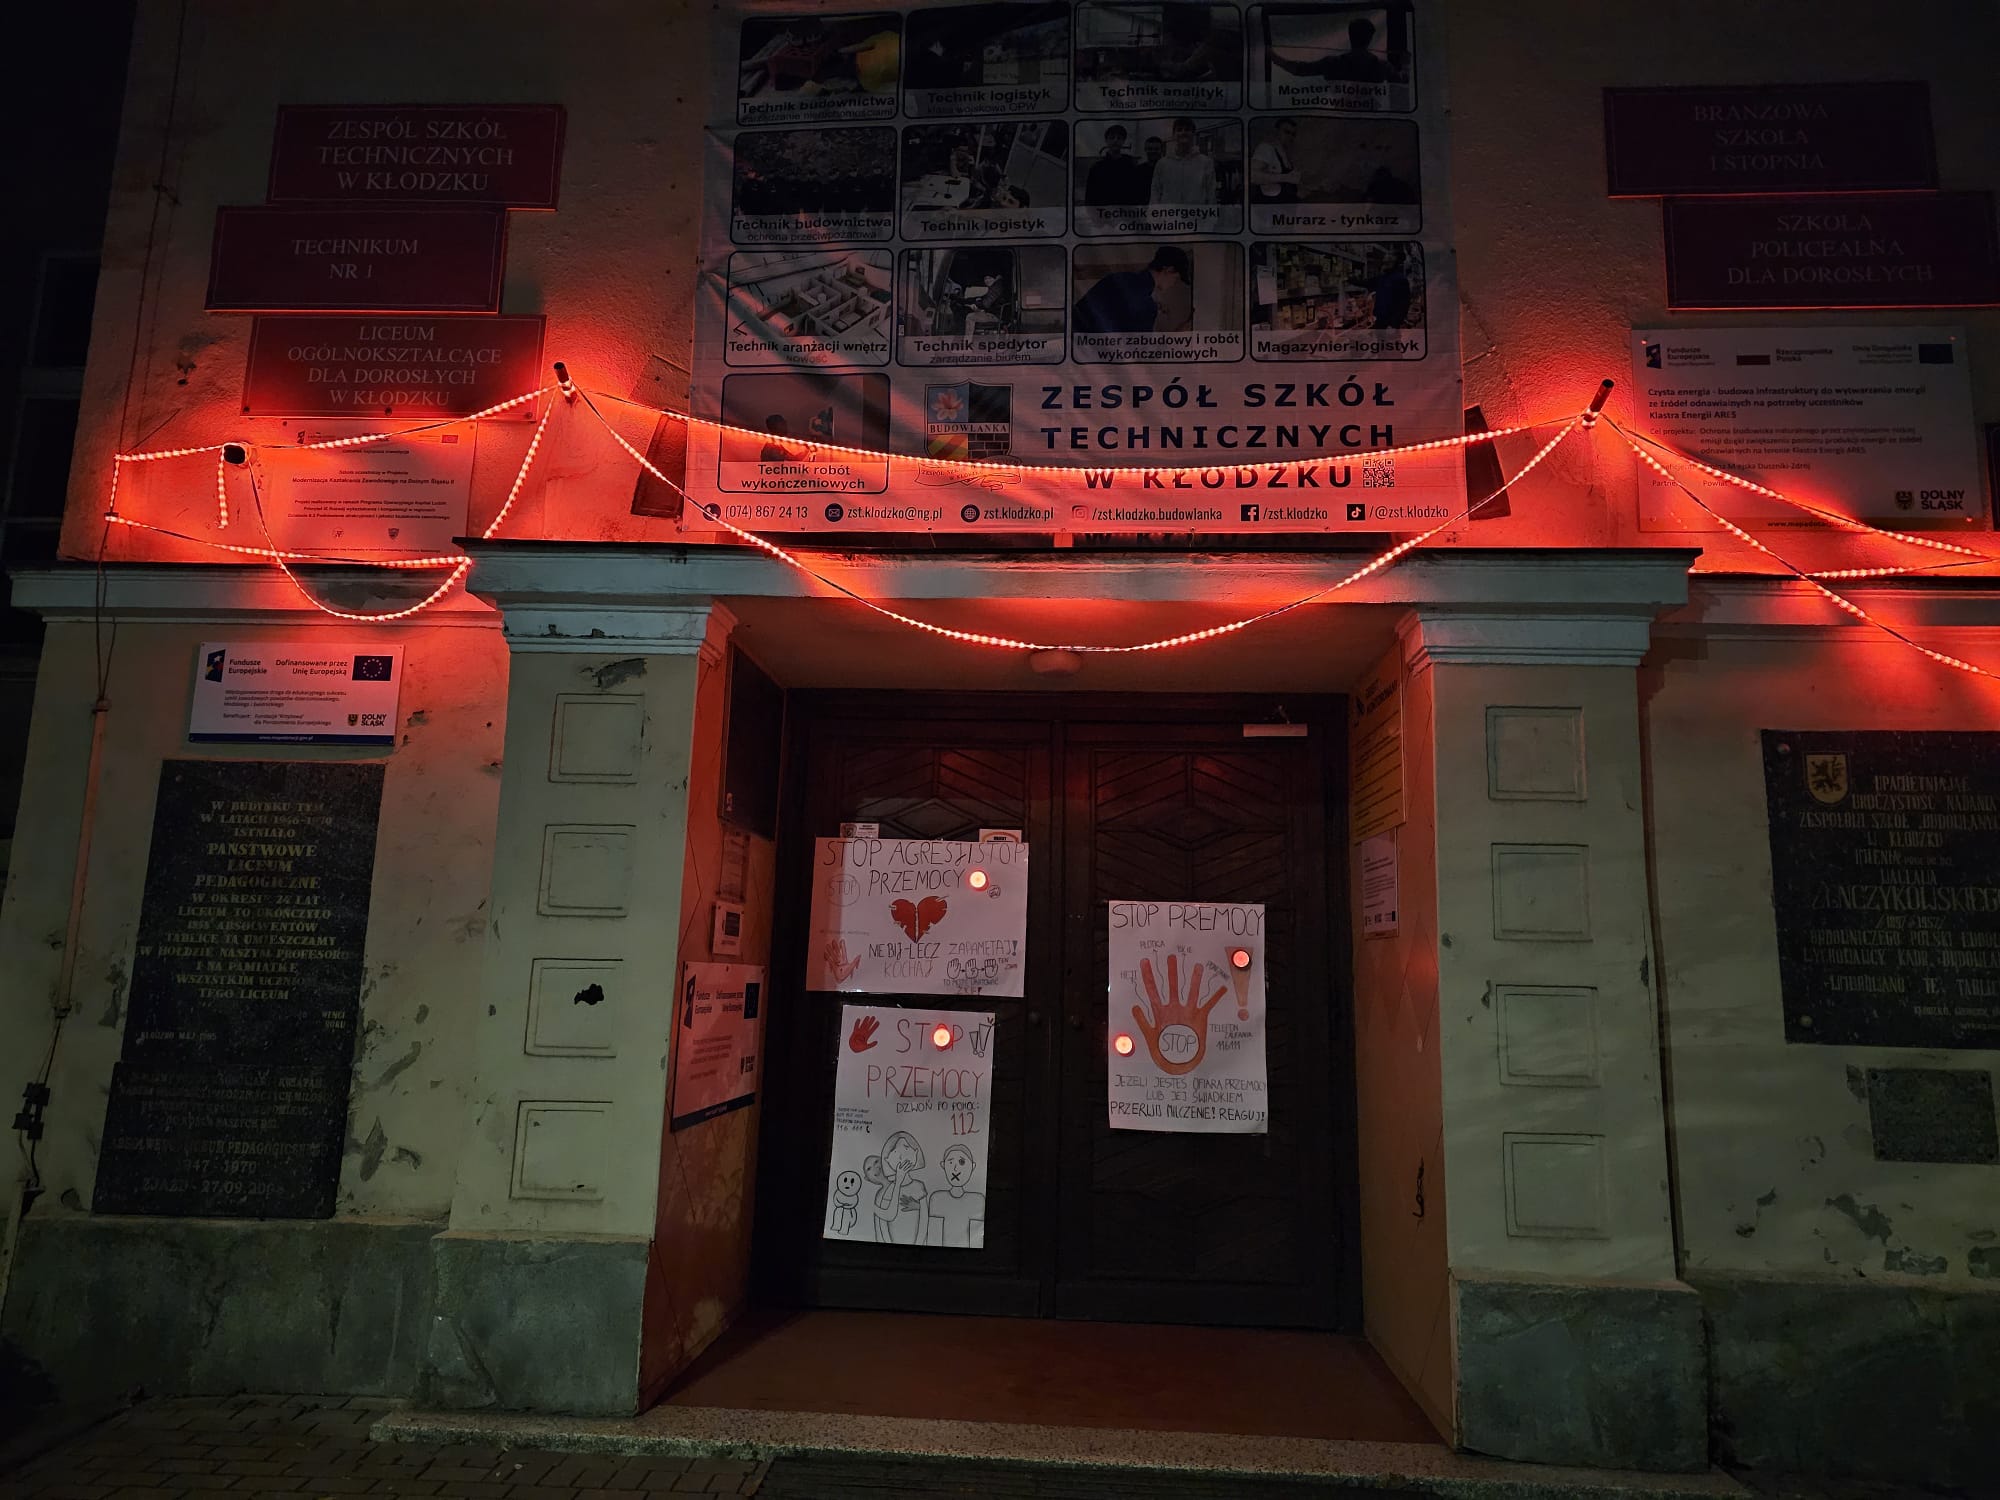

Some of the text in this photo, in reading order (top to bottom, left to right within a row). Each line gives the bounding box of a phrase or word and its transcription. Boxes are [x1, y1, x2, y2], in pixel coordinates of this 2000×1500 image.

[927, 88, 1051, 105] Technik logistyk
[1100, 86, 1224, 100] Technik analityk
[1278, 83, 1388, 97] Monter stolarki
[741, 94, 896, 115] Technik budownictwa
[1291, 95, 1374, 110] budowlanej
[327, 114, 507, 140] ZESPÓŁ SZKÓŁ
[318, 145, 514, 167] TECHNICZNYCH
[1724, 153, 1825, 170] STOPNIA
[336, 172, 489, 192] W KŁODZKU
[1096, 207, 1221, 221] Technik energetyki
[1271, 213, 1400, 228] Murarz tynkarz
[735, 216, 892, 232] Technik budownictwa
[920, 217, 1046, 235] Technik logistyk
[1118, 219, 1199, 232] odnawialnej
[290, 238, 419, 257] TECHNIKUM
[1750, 239, 1905, 260] POLICEALNA
[328, 263, 359, 280] NR
[1727, 263, 1936, 286] DLA DOROSŁYCH
[358, 324, 436, 343] LICEUM
[1076, 332, 1240, 349] Monter zabudowy i robót
[728, 340, 888, 355] Technik aranżacji wnętrz
[914, 338, 1048, 354] Technik spedytor
[1257, 339, 1420, 355] Magazynier-logistyk
[287, 341, 503, 369] OGÓLNOKSZTAŁCĄCE
[1097, 347, 1218, 361] wykończeniowych
[307, 367, 477, 386] DLA DOROSŁYCH
[329, 389, 450, 408] W KŁODZKU
[1041, 374, 1395, 410] ZESPÓŁ SZKÓŁ
[1648, 388, 1675, 397] Czysta
[1677, 388, 1711, 398] energia
[1718, 387, 1754, 396] budowa
[1756, 386, 1818, 396] infrastruktury
[1821, 386, 1833, 395] do
[1690, 399, 1752, 409] odnawialnych
[1767, 398, 1806, 409] potrzeby
[1808, 398, 1864, 407] uczestników
[1649, 411, 1680, 420] Klastra
[1681, 411, 1712, 421] Energii
[929, 424, 1008, 434] BUDOWLANKA
[1040, 424, 1394, 450] TECHNICZNYCH
[759, 463, 851, 475] Technik robót
[741, 476, 866, 492] wykończeniowych
[1083, 465, 1353, 490] W KŁODZKU
[1920, 489, 1965, 500] DOLNY
[725, 505, 809, 520] (074) 867 24 13
[1369, 504, 1450, 520] /@zst.klodzko
[1921, 498, 1964, 512] ŚLĄSK
[847, 505, 943, 521] zst.klodzko@ng.pl
[984, 506, 1055, 521] zst.klodzko.pl
[1091, 507, 1223, 522] /zst.klodzko.budowlanka
[1262, 506, 1329, 521] /zst.klodzko
[228, 667, 348, 677] Europejskie Unię Europejską
[275, 659, 328, 667] Dofinansowane
[329, 660, 349, 670] przez
[361, 719, 385, 727] ŚLĄSK
[211, 800, 225, 812] W
[200, 814, 268, 825] W LATACH
[233, 827, 296, 839] ISTNIAŁO
[1889, 831, 1943, 848] KŁODZKU
[206, 842, 318, 858] PAŃSTWOWE
[823, 838, 1026, 868] STOP AGRESJI STOP
[227, 860, 293, 873] LICEUM
[193, 875, 321, 890] PEDAGOGICZNE
[827, 880, 857, 897] STOP
[868, 867, 966, 897] PRZEMOCY
[191, 893, 321, 906] W LAT
[178, 906, 227, 918] LICEUM
[234, 907, 252, 919] TO
[1112, 903, 1265, 937] STOP PREMOCY
[138, 946, 152, 957] W
[206, 961, 224, 972] NA
[884, 959, 936, 979] KOCHAJ
[175, 974, 256, 986] WSZYSTKIM
[199, 988, 290, 1001] TEGO LICEUM
[1161, 1032, 1197, 1054] STOP
[866, 1064, 985, 1100] PRZEMOCY
[1145, 1090, 1187, 1101] LUB JEJ
[896, 1101, 948, 1114] DZWOŃ PO
[1219, 1107, 1266, 1122] REAGUJ!
[950, 1111, 981, 1136] 112
